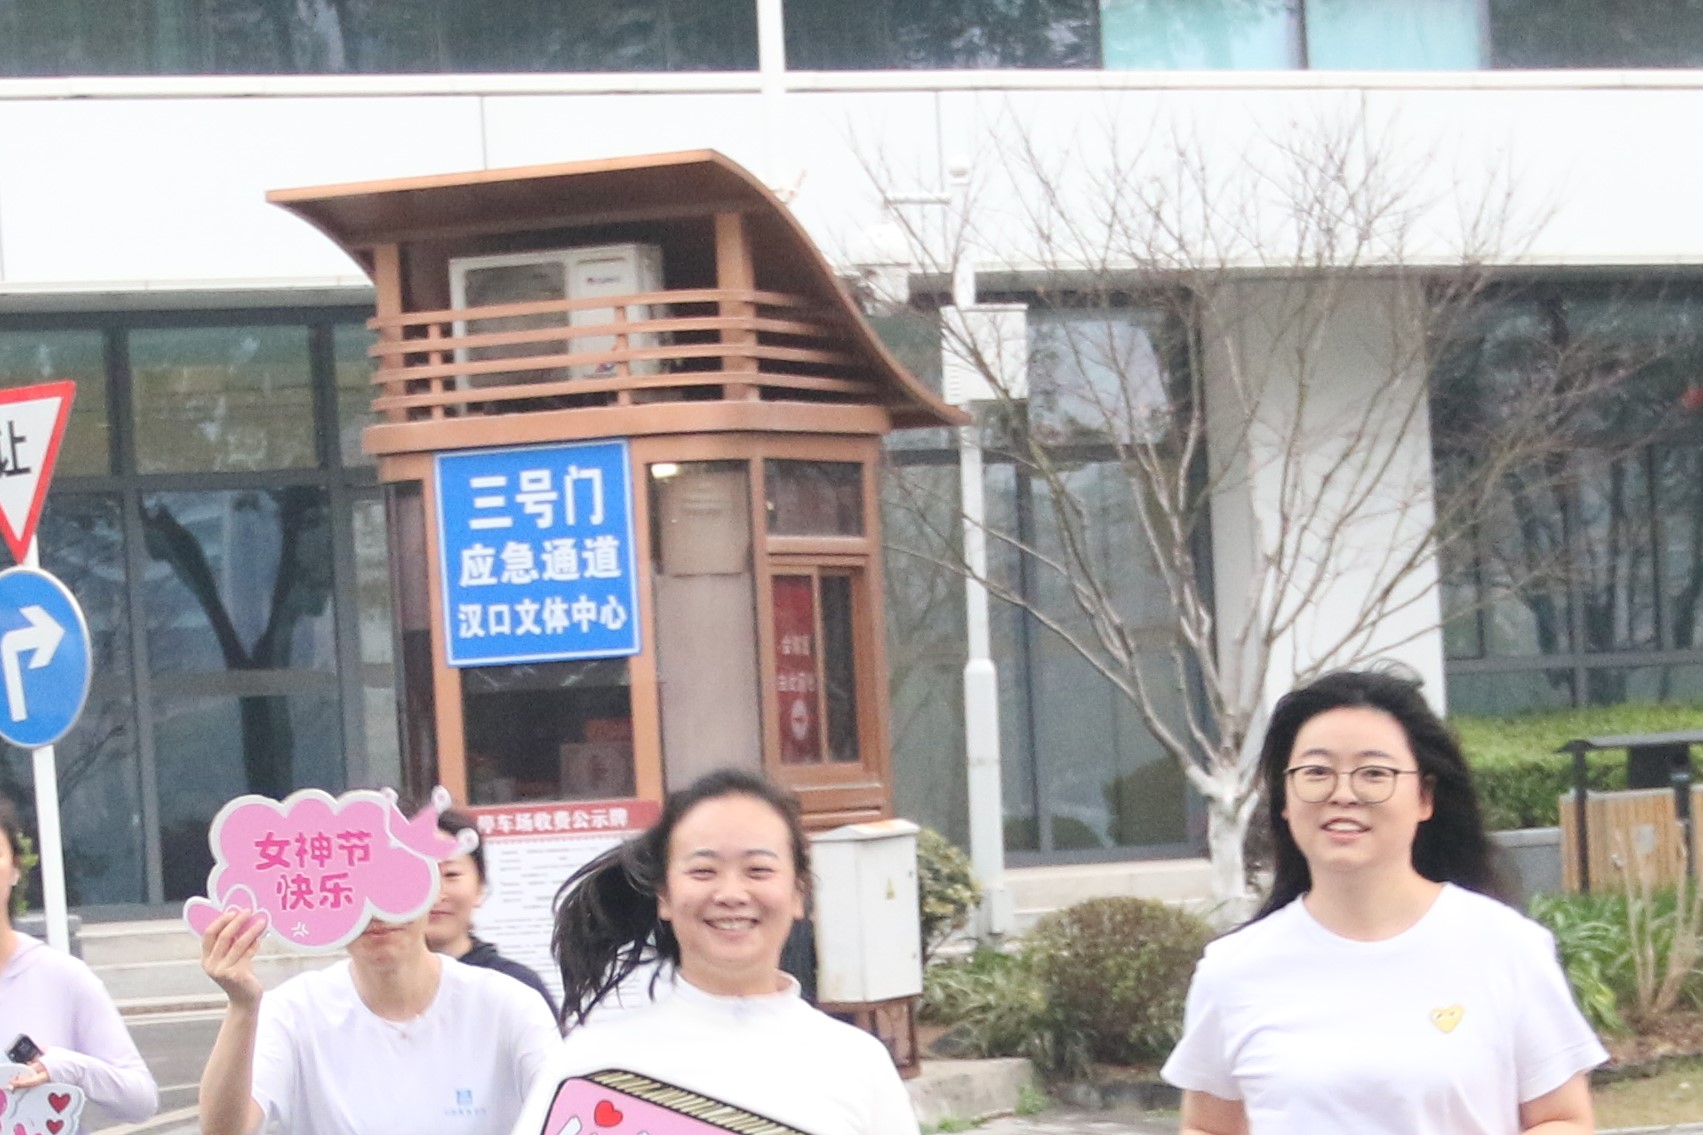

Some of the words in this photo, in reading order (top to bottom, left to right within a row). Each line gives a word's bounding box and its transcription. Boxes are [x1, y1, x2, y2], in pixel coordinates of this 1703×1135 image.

[467, 464, 606, 530] 三号门
[459, 535, 623, 588] 应急通道
[457, 594, 628, 639] 汉口文体中心
[476, 807, 629, 834] 停车场收费公示牌
[254, 830, 373, 871] 女神节
[276, 872, 354, 911] 快乐
